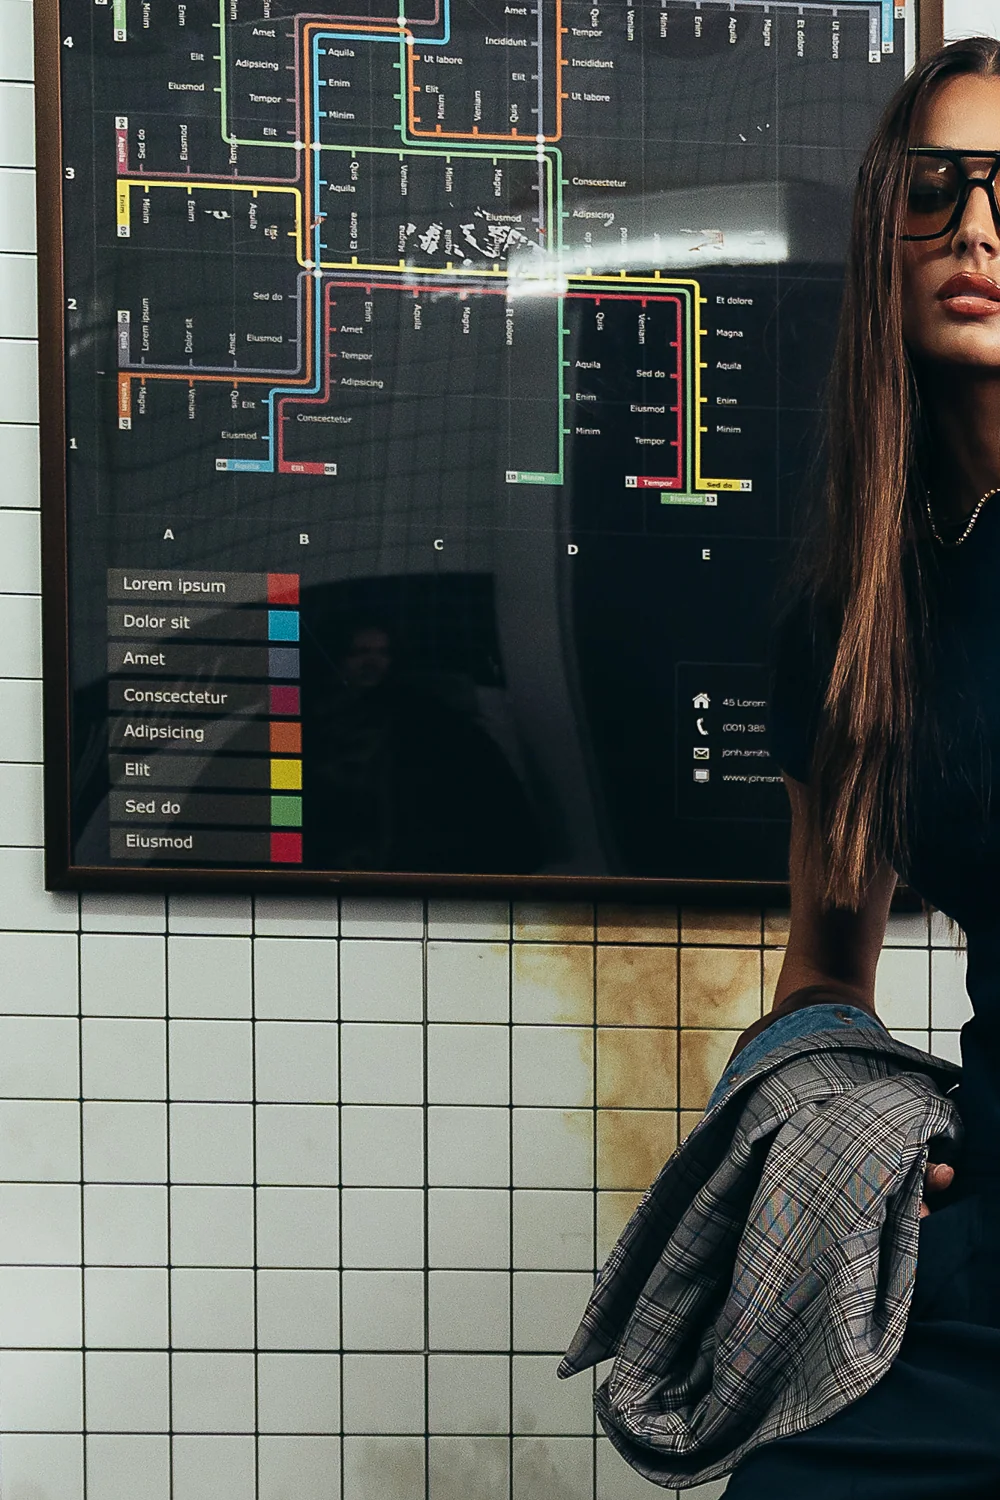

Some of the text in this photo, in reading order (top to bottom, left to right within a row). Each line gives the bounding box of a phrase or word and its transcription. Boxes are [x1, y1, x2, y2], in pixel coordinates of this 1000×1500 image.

[178, 5, 186, 26] Enim
[504, 6, 527, 15] Amet
[590, 9, 599, 27] Quis
[627, 10, 635, 41] Veniam
[660, 12, 668, 38] Minim
[694, 16, 702, 38] Enim
[252, 28, 275, 37] Amet
[572, 28, 603, 37] Tempor
[729, 17, 737, 44] Aquila
[763, 19, 772, 47] Magna
[64, 36, 74, 48] 4
[485, 37, 527, 46] Incididunt
[190, 53, 204, 61] Elit
[328, 48, 355, 57] Aquila
[235, 59, 279, 71] Adipsicing
[436, 56, 463, 65] labore
[572, 59, 614, 68] Incididunt
[512, 73, 526, 81] Elit
[168, 82, 205, 91] Eiusmod
[329, 79, 350, 87] Enim
[426, 85, 439, 93] Elit
[249, 94, 281, 104] Tempor
[571, 93, 610, 102] Ut labore
[329, 111, 355, 119] Minim
[509, 104, 518, 123] Quis
[263, 128, 277, 136] Elit
[180, 125, 188, 161] Eiusmod
[118, 136, 126, 163] Aquila
[65, 168, 75, 179] 3
[351, 162, 359, 180] Quis
[445, 167, 454, 192] Minim
[494, 169, 502, 196] Magna
[573, 177, 626, 187] Conscectetur
[329, 183, 355, 193] Aquila
[143, 199, 151, 224] Minim
[187, 200, 196, 222] Enim
[249, 203, 258, 229] Aquila
[573, 210, 615, 220] Adipsicing
[253, 292, 283, 301] Sed do
[716, 297, 753, 306] Et dolore
[67, 299, 77, 309] 2
[142, 298, 150, 323] ipsum
[414, 304, 422, 330] Aquila
[597, 312, 605, 331] Quis
[341, 325, 363, 334] Amet
[638, 313, 646, 345] Veniam
[716, 329, 743, 339] Magna
[247, 334, 282, 343] Eiusmod
[341, 352, 372, 361] Tempor
[575, 360, 601, 370] Aquila
[716, 362, 742, 371] Aquila
[636, 370, 665, 378] Sed do
[341, 378, 384, 389] Adipsicing
[231, 390, 239, 409] Quis
[716, 397, 737, 405] Enim
[242, 401, 255, 409] Elit
[630, 405, 665, 413] Eiusmod
[297, 414, 352, 423] Conscectetur
[716, 425, 741, 434] Minim
[221, 431, 257, 440] Eiusmod
[70, 438, 77, 449] 1
[635, 438, 665, 446] Tempor
[643, 479, 673, 488] Tempor
[163, 529, 174, 540] A
[300, 534, 309, 545] B
[434, 540, 443, 550] C
[568, 545, 578, 555] D
[702, 549, 710, 560] E
[123, 577, 226, 596] Lorem ipsum
[123, 614, 190, 629] Dolor sit
[123, 651, 166, 665] Amet
[123, 688, 228, 704] Conscectetur
[124, 724, 205, 743] Adipsicing
[723, 724, 745, 733] (001)
[125, 763, 150, 777] Elit
[125, 800, 181, 815] Sed do
[126, 834, 192, 849] Eiusmod
